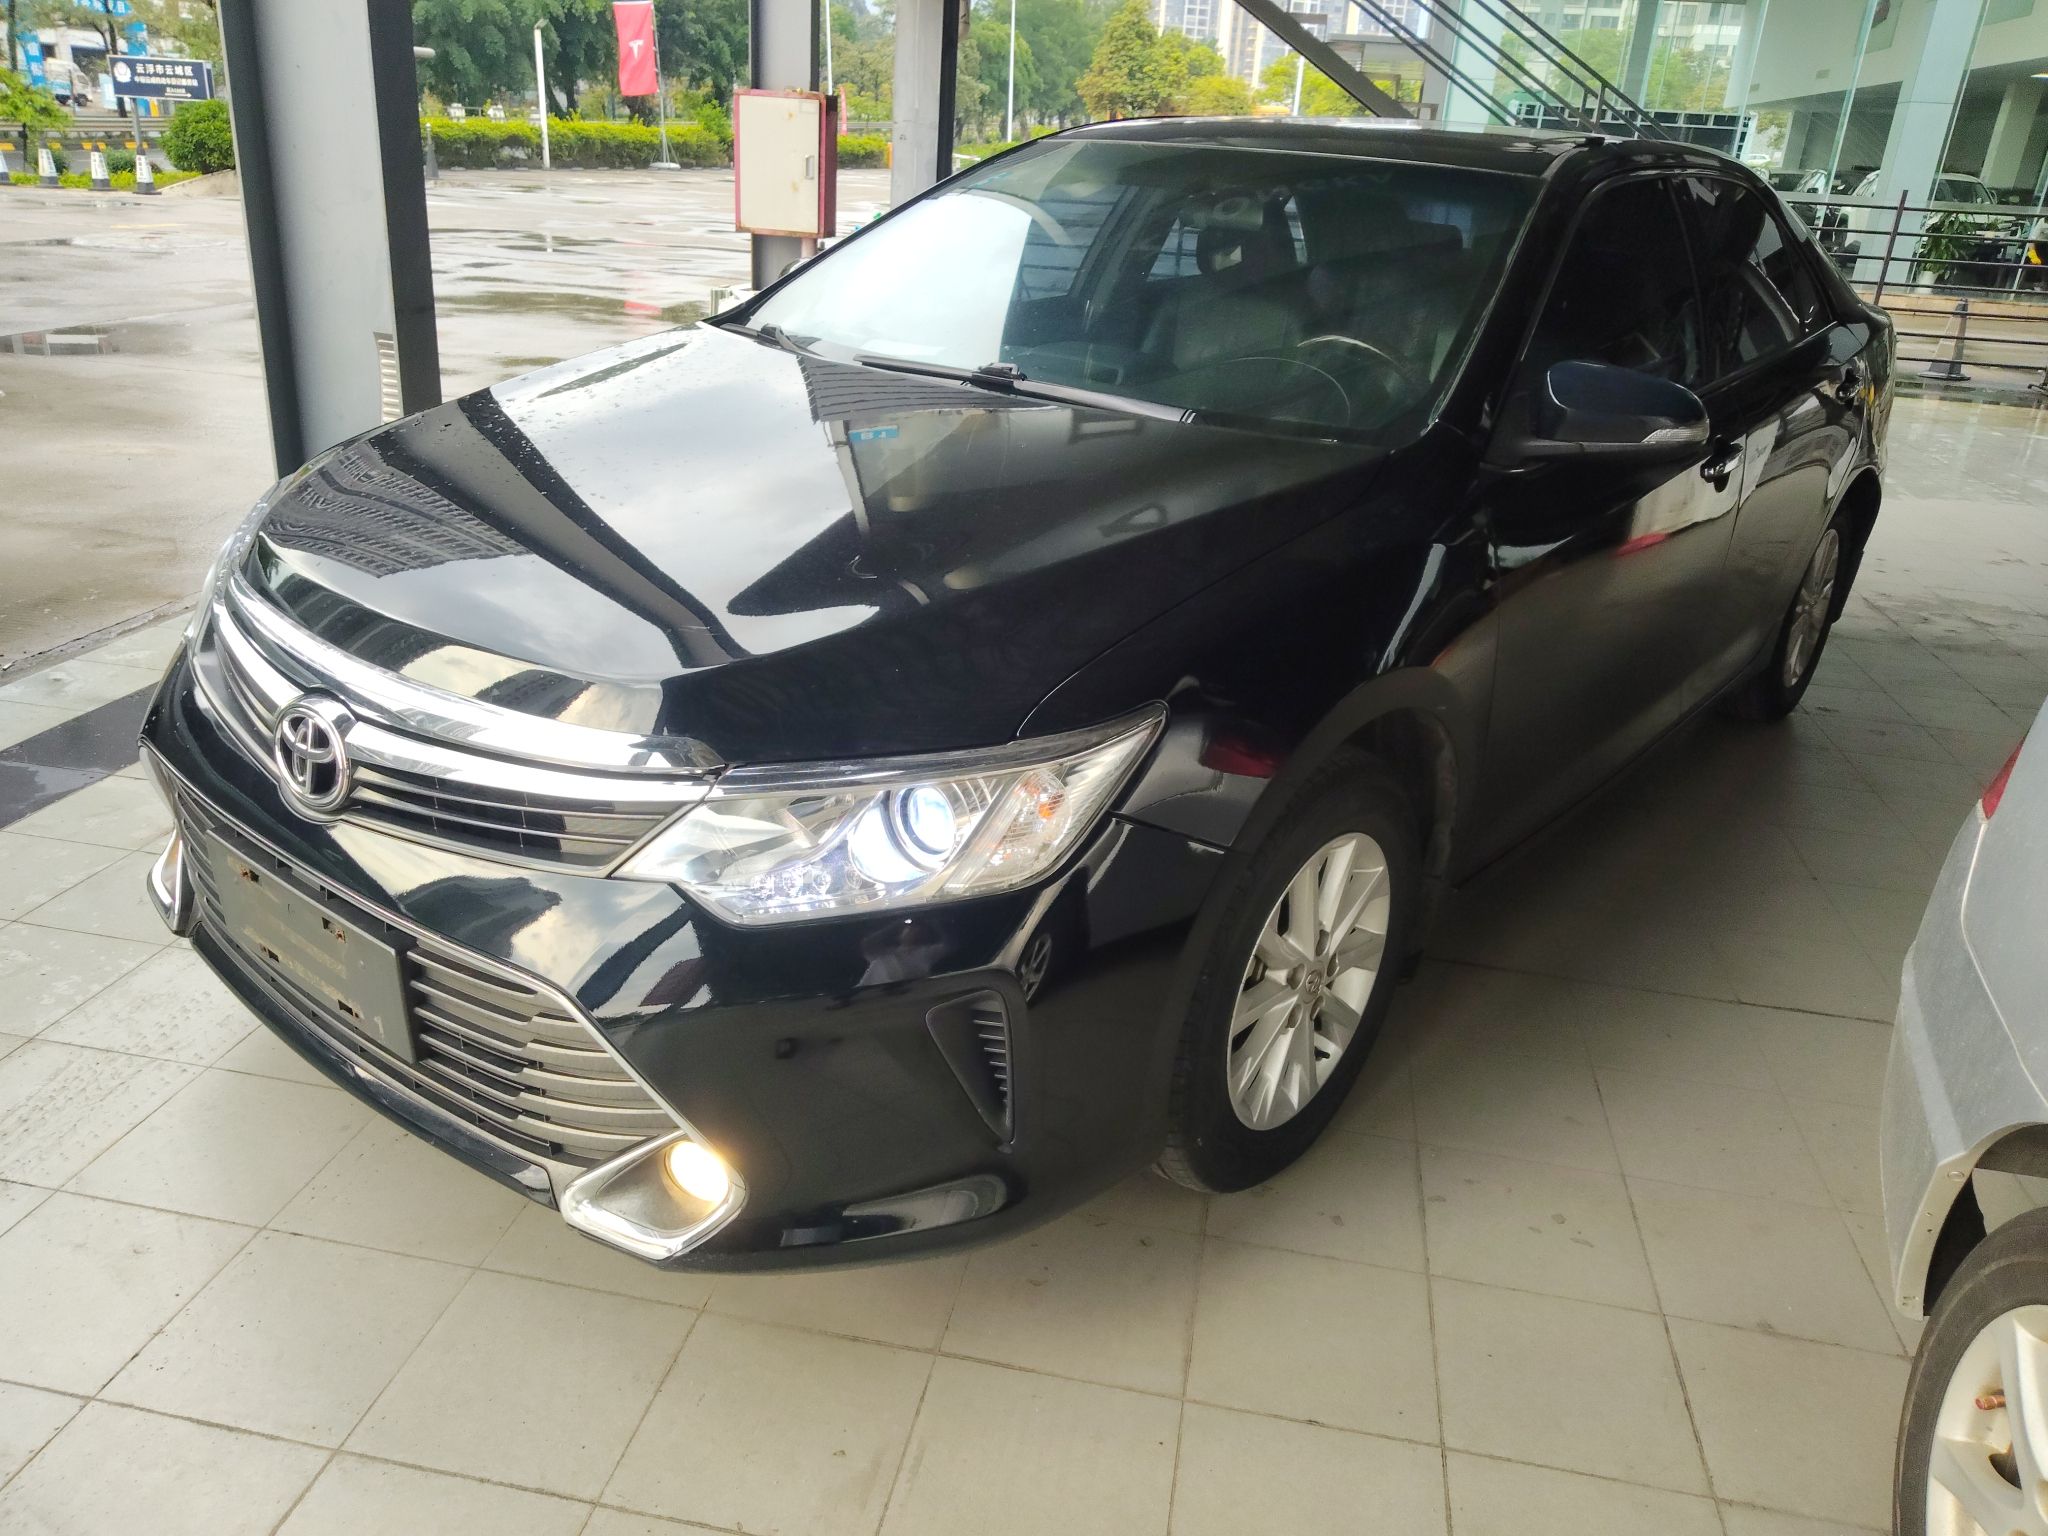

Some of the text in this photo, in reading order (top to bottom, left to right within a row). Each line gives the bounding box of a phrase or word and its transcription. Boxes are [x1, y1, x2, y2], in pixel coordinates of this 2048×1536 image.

[136, 63, 194, 76] 云浮市云城区
